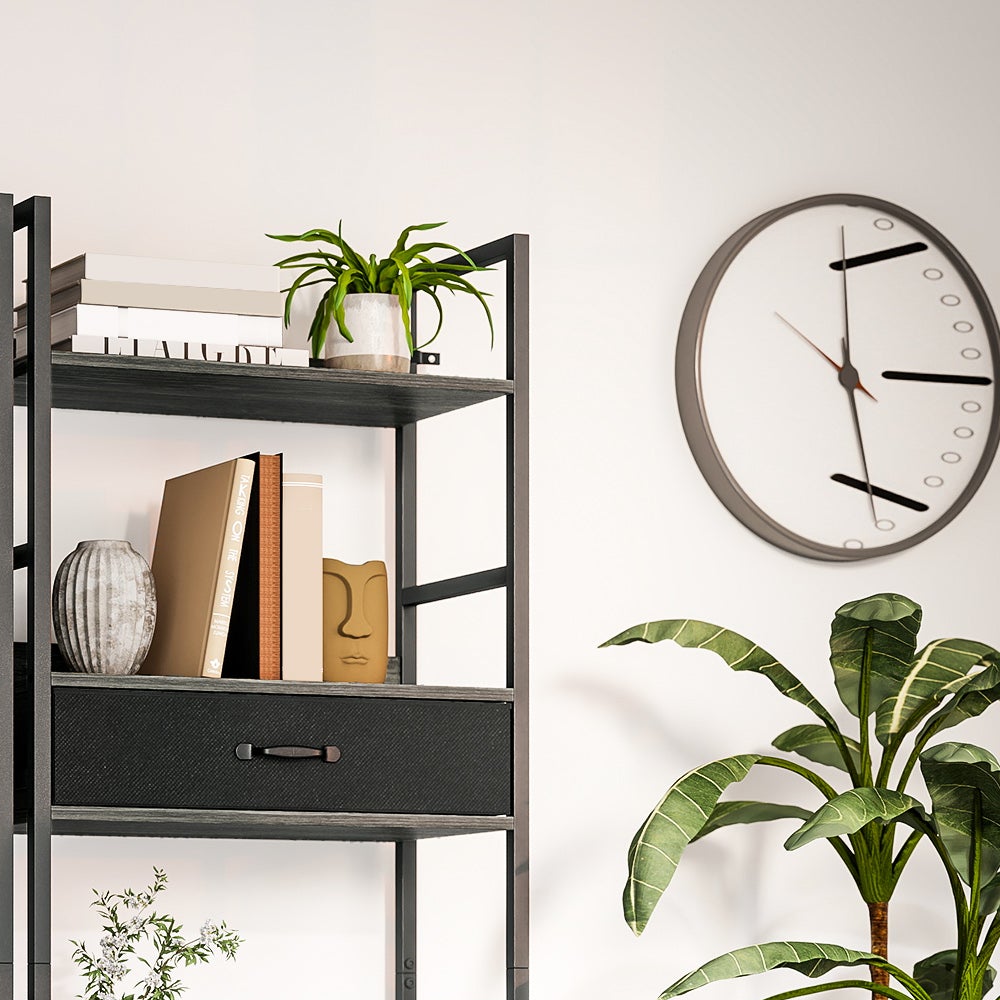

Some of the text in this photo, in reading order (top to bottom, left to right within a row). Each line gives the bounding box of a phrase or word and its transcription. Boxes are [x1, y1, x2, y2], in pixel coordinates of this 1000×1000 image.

[231, 521, 242, 542] ON
[228, 550, 238, 562] THE
[220, 570, 234, 608] SYSTEM
